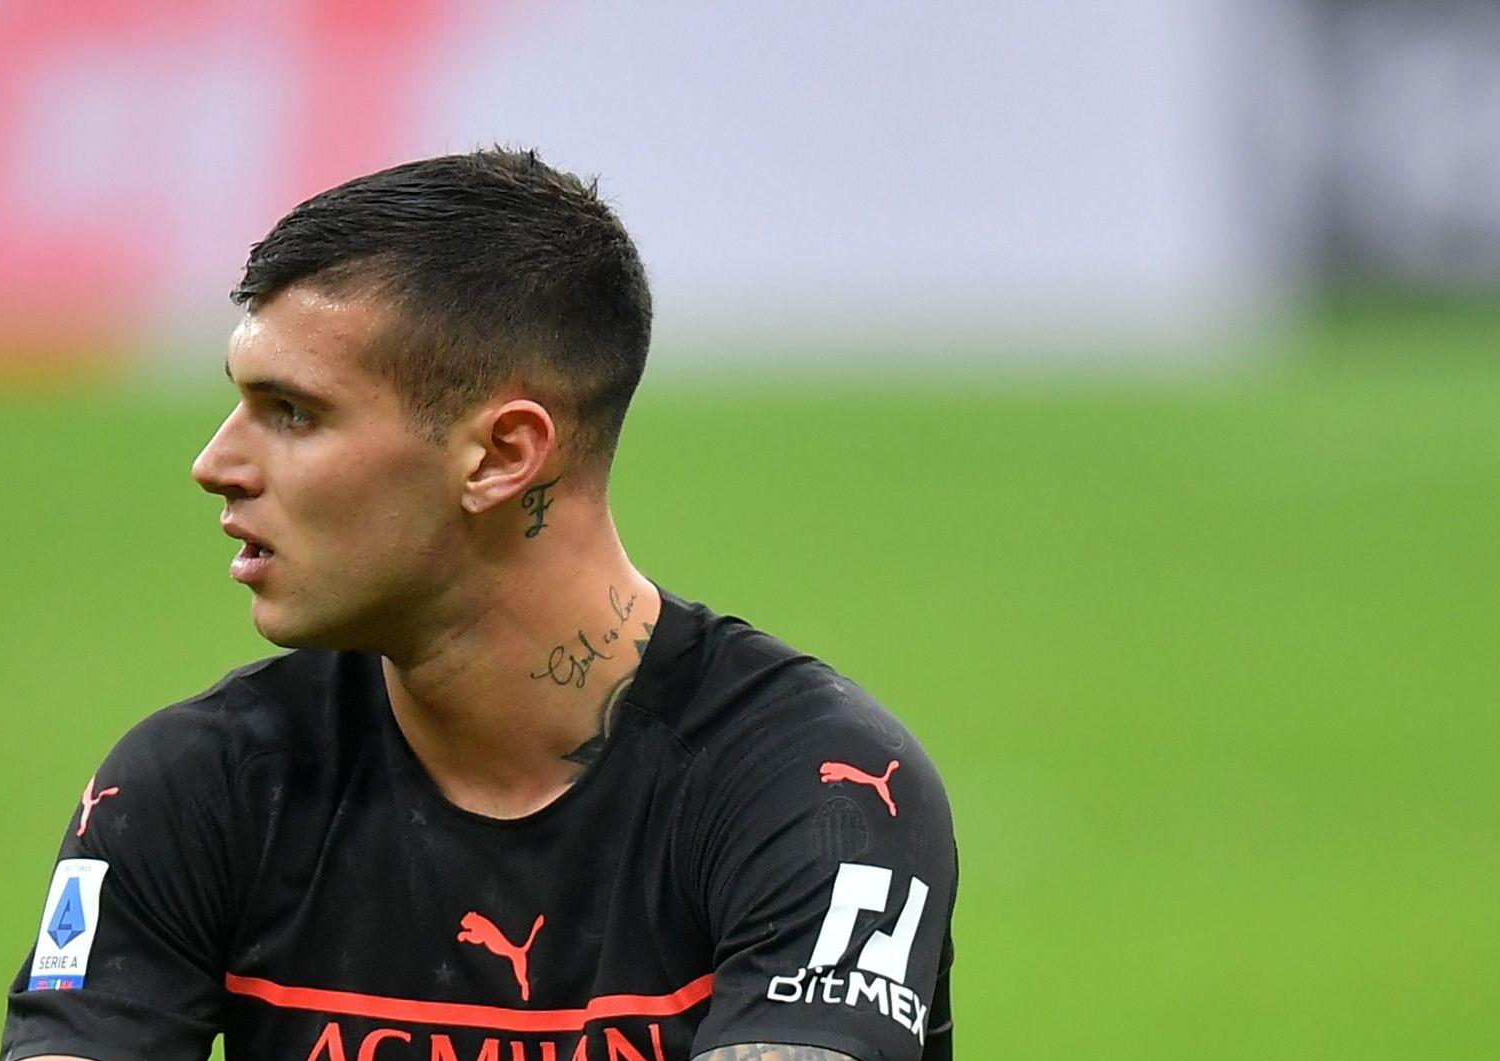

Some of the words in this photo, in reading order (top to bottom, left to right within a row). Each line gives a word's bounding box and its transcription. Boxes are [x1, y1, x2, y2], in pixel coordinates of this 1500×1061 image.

[38, 955, 69, 970] SERIE
[70, 955, 78, 970] A
[766, 966, 928, 1047] BitMEX
